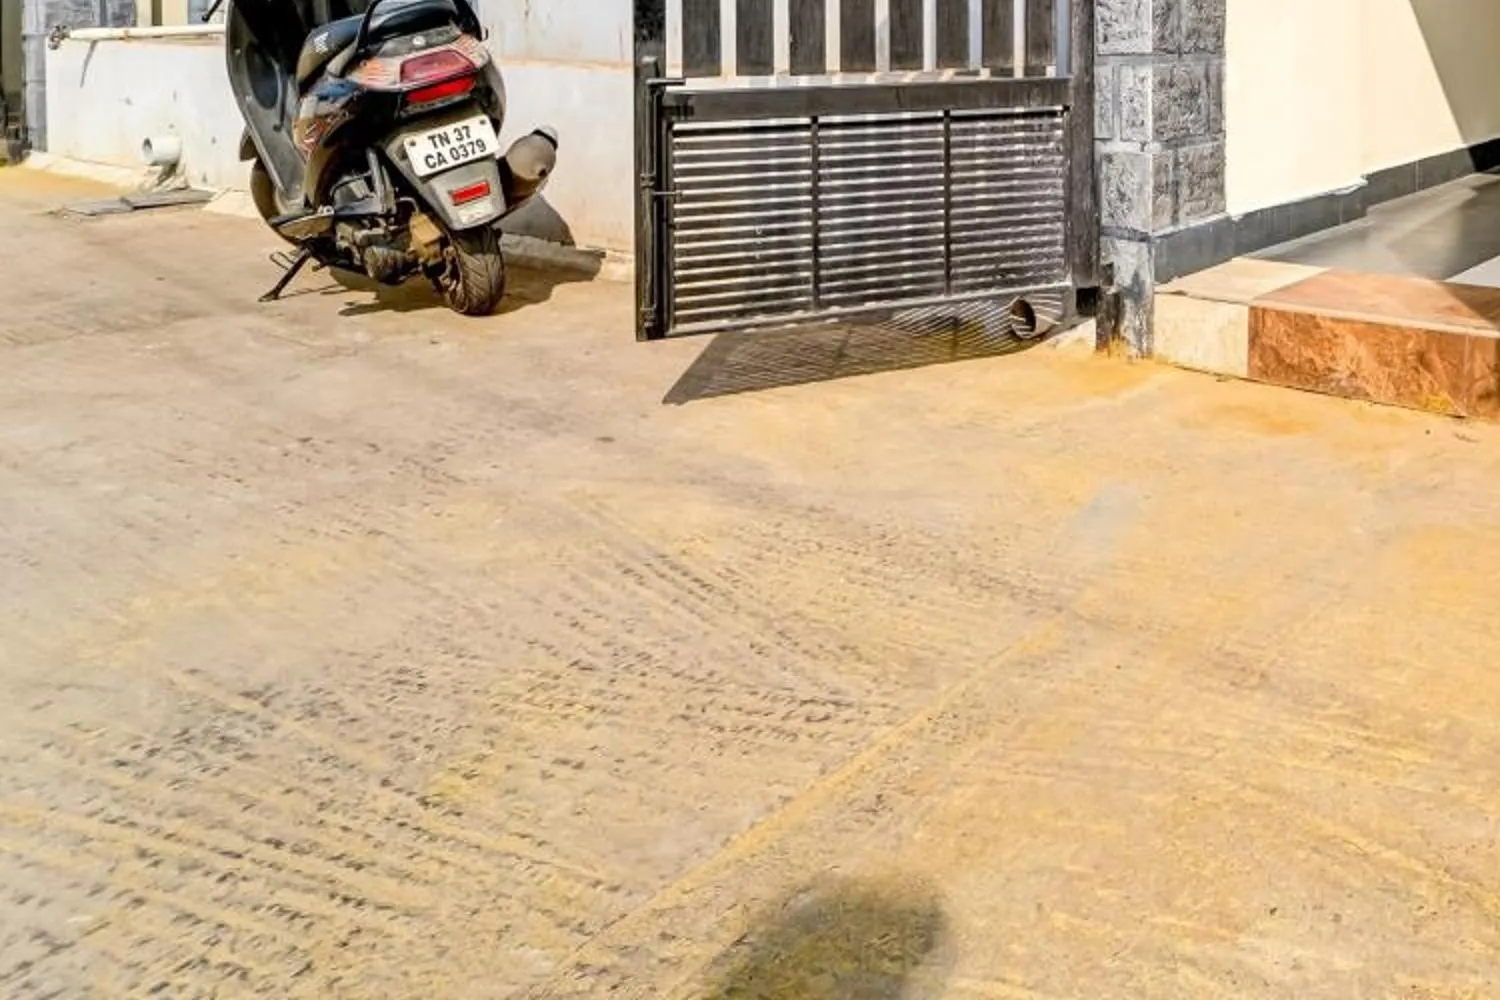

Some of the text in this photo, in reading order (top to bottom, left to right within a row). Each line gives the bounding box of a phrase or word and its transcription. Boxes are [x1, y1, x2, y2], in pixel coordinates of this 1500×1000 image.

[428, 125, 472, 149] TN 37
[424, 138, 487, 169] CA 0379
